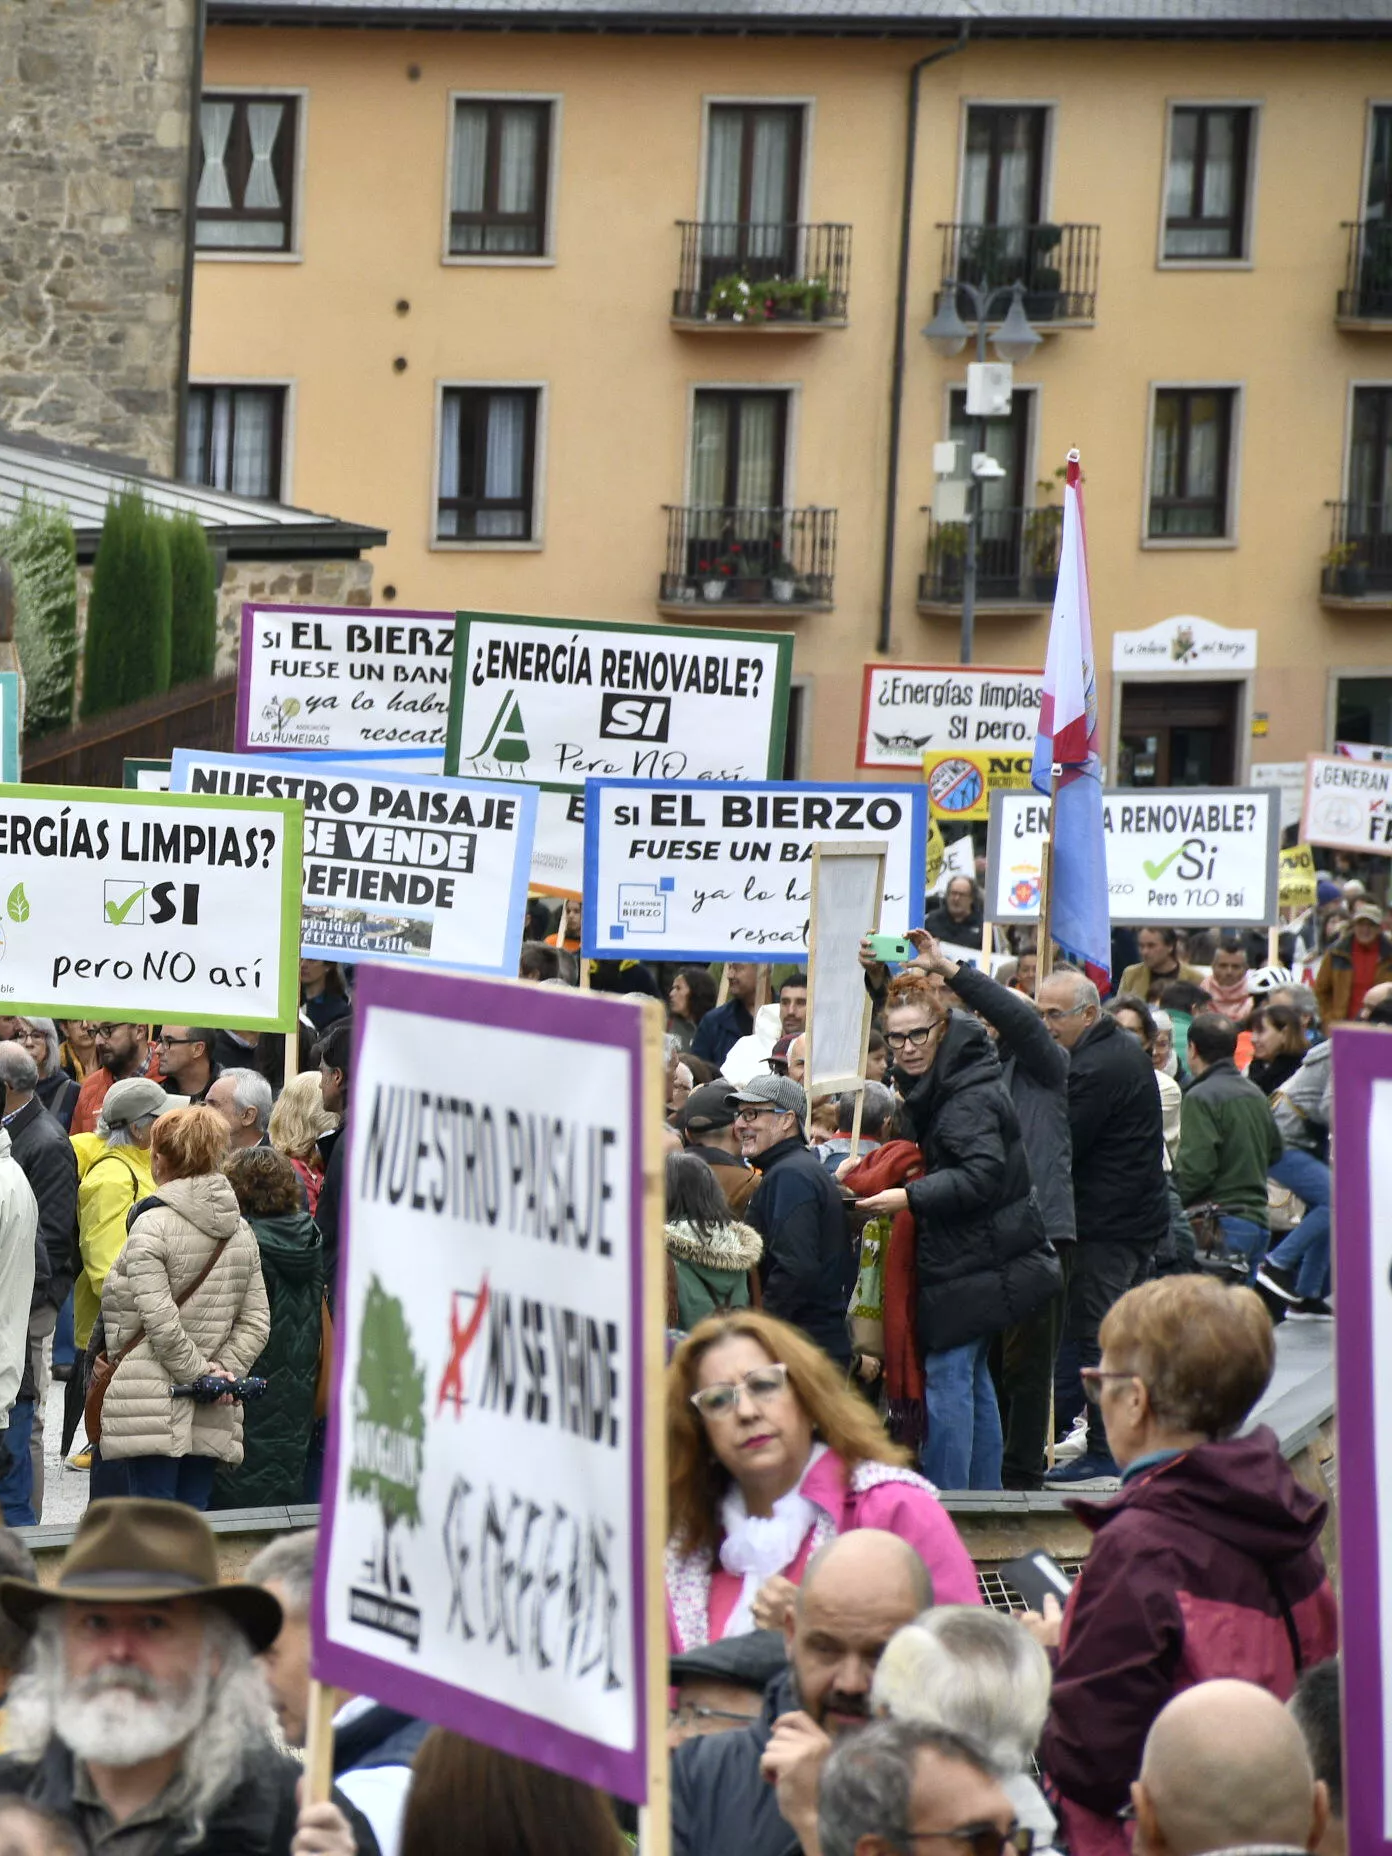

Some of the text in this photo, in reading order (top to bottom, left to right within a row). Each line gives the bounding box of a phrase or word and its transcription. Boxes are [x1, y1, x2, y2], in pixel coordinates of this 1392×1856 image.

[262, 631, 281, 649] SI
[292, 622, 332, 651] EL
[270, 659, 451, 684] FUESE UN BAN
[472, 634, 764, 698] ¿ENERGÍA RENOVABLE?
[305, 689, 448, 714] ya lo habr
[878, 677, 973, 707] ¿Energías
[605, 699, 667, 737] SI
[949, 715, 967, 740] SI
[250, 731, 329, 746] LAS HUMEIRAS
[555, 743, 622, 774] Pero
[988, 758, 1032, 773] NO
[192, 768, 359, 815] NUESTRO
[368, 786, 516, 831] PAISAJE
[614, 806, 640, 826] SI
[651, 794, 706, 826] EL
[722, 795, 903, 831] BIERZO
[1121, 804, 1256, 833] RENOVABLE?
[121, 821, 276, 869] LIMPIAS?
[344, 823, 470, 870] VENDE
[629, 839, 721, 860] FUESE
[730, 841, 772, 862] UN
[303, 864, 456, 908] EFIENDE
[694, 887, 732, 912] ya
[744, 876, 775, 901] lo
[1148, 889, 1177, 907] Pero
[1226, 888, 1244, 907] así
[149, 881, 200, 925] SI
[622, 909, 662, 917] BIERZO
[375, 938, 414, 952] Lillo
[53, 950, 263, 988] pero NO así
[362, 1083, 615, 1257] NUESTRO PAISAJE
[478, 1289, 618, 1449] NO SE VENDE
